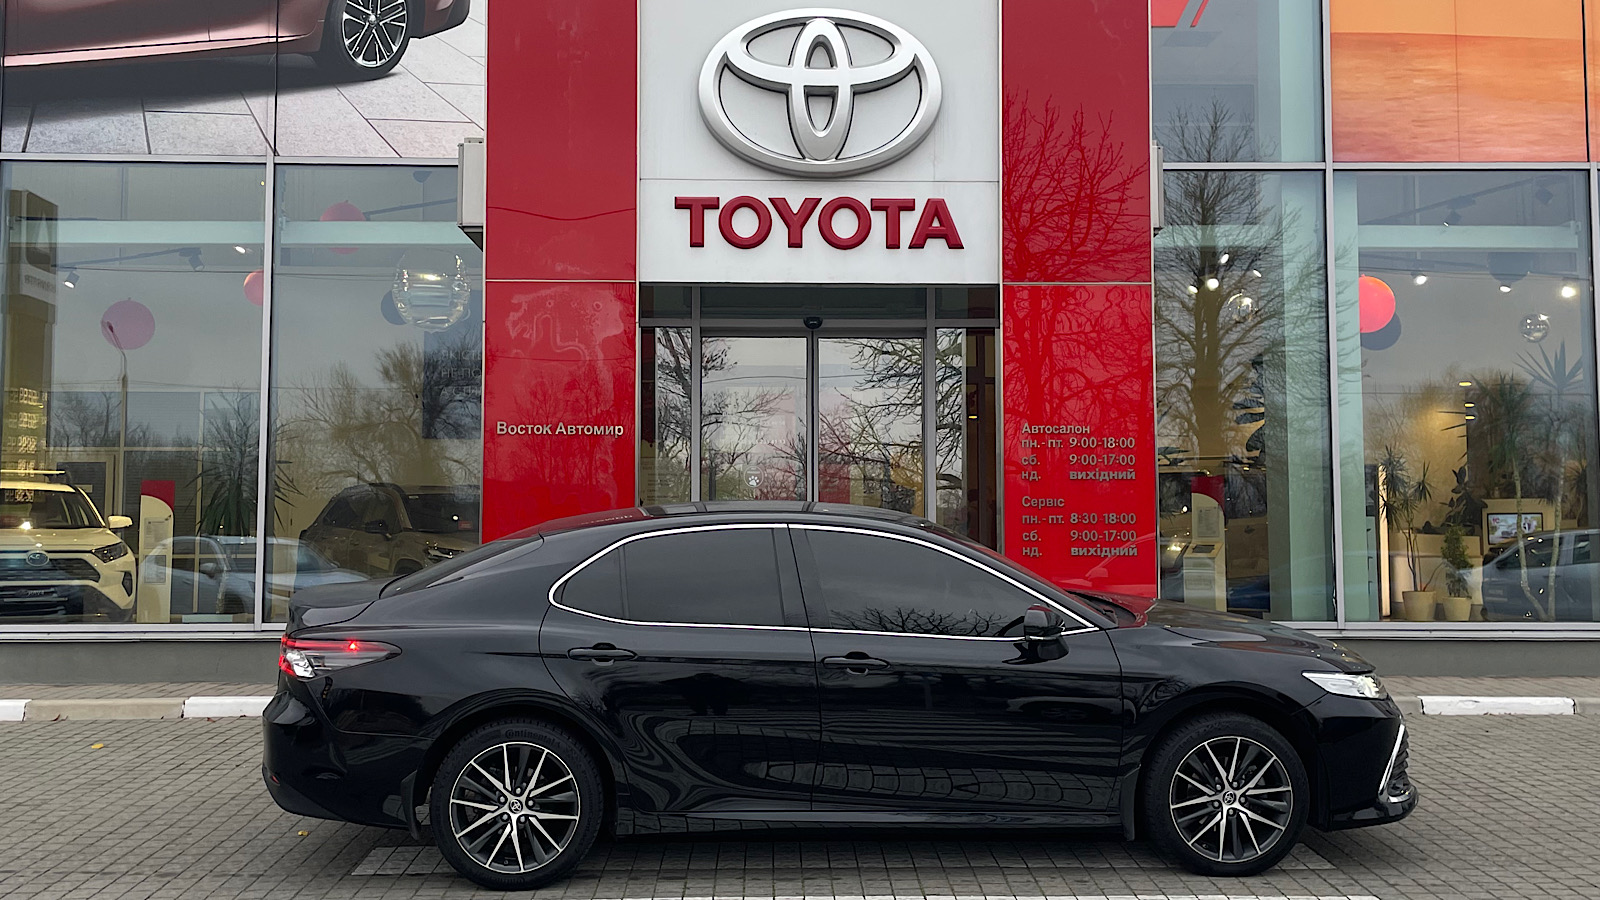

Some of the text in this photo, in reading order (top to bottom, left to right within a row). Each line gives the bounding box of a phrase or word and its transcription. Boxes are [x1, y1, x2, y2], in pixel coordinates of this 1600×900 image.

[674, 195, 965, 250] TOYOTA
[496, 421, 624, 438] Восток Автомир
[1021, 423, 1090, 434] Автосалон
[1021, 454, 1041, 465] сб.
[1021, 468, 1136, 481] нд. вихідний
[1021, 496, 1065, 509] Сервіс
[1022, 530, 1042, 541] сб.
[1022, 544, 1138, 558] нд. вихідний
